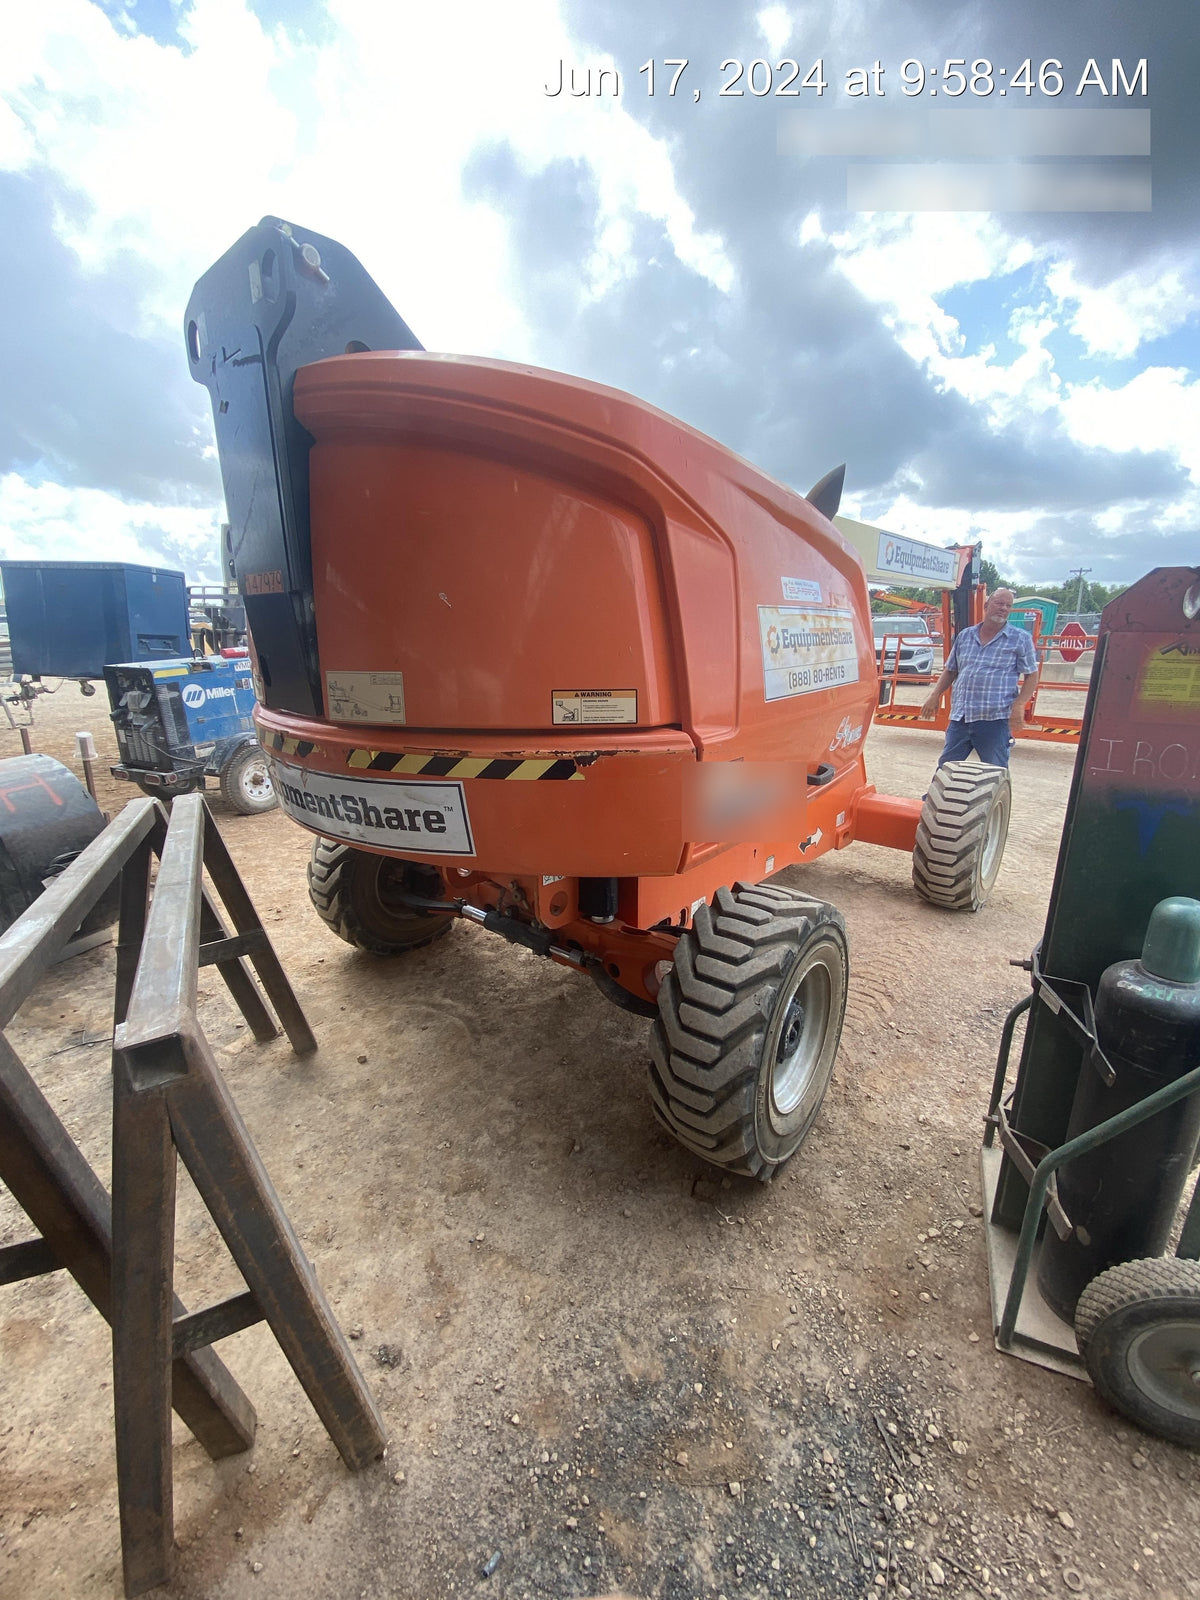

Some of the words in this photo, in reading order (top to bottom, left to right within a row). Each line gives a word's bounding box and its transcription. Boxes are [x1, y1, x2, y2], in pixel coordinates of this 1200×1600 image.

[894, 545, 951, 574] EquipmentShare
[780, 627, 853, 654] EquipmentShare
[788, 668, 811, 690] (888)
[813, 665, 845, 684] 80-RENTS
[206, 686, 236, 700] Miller
